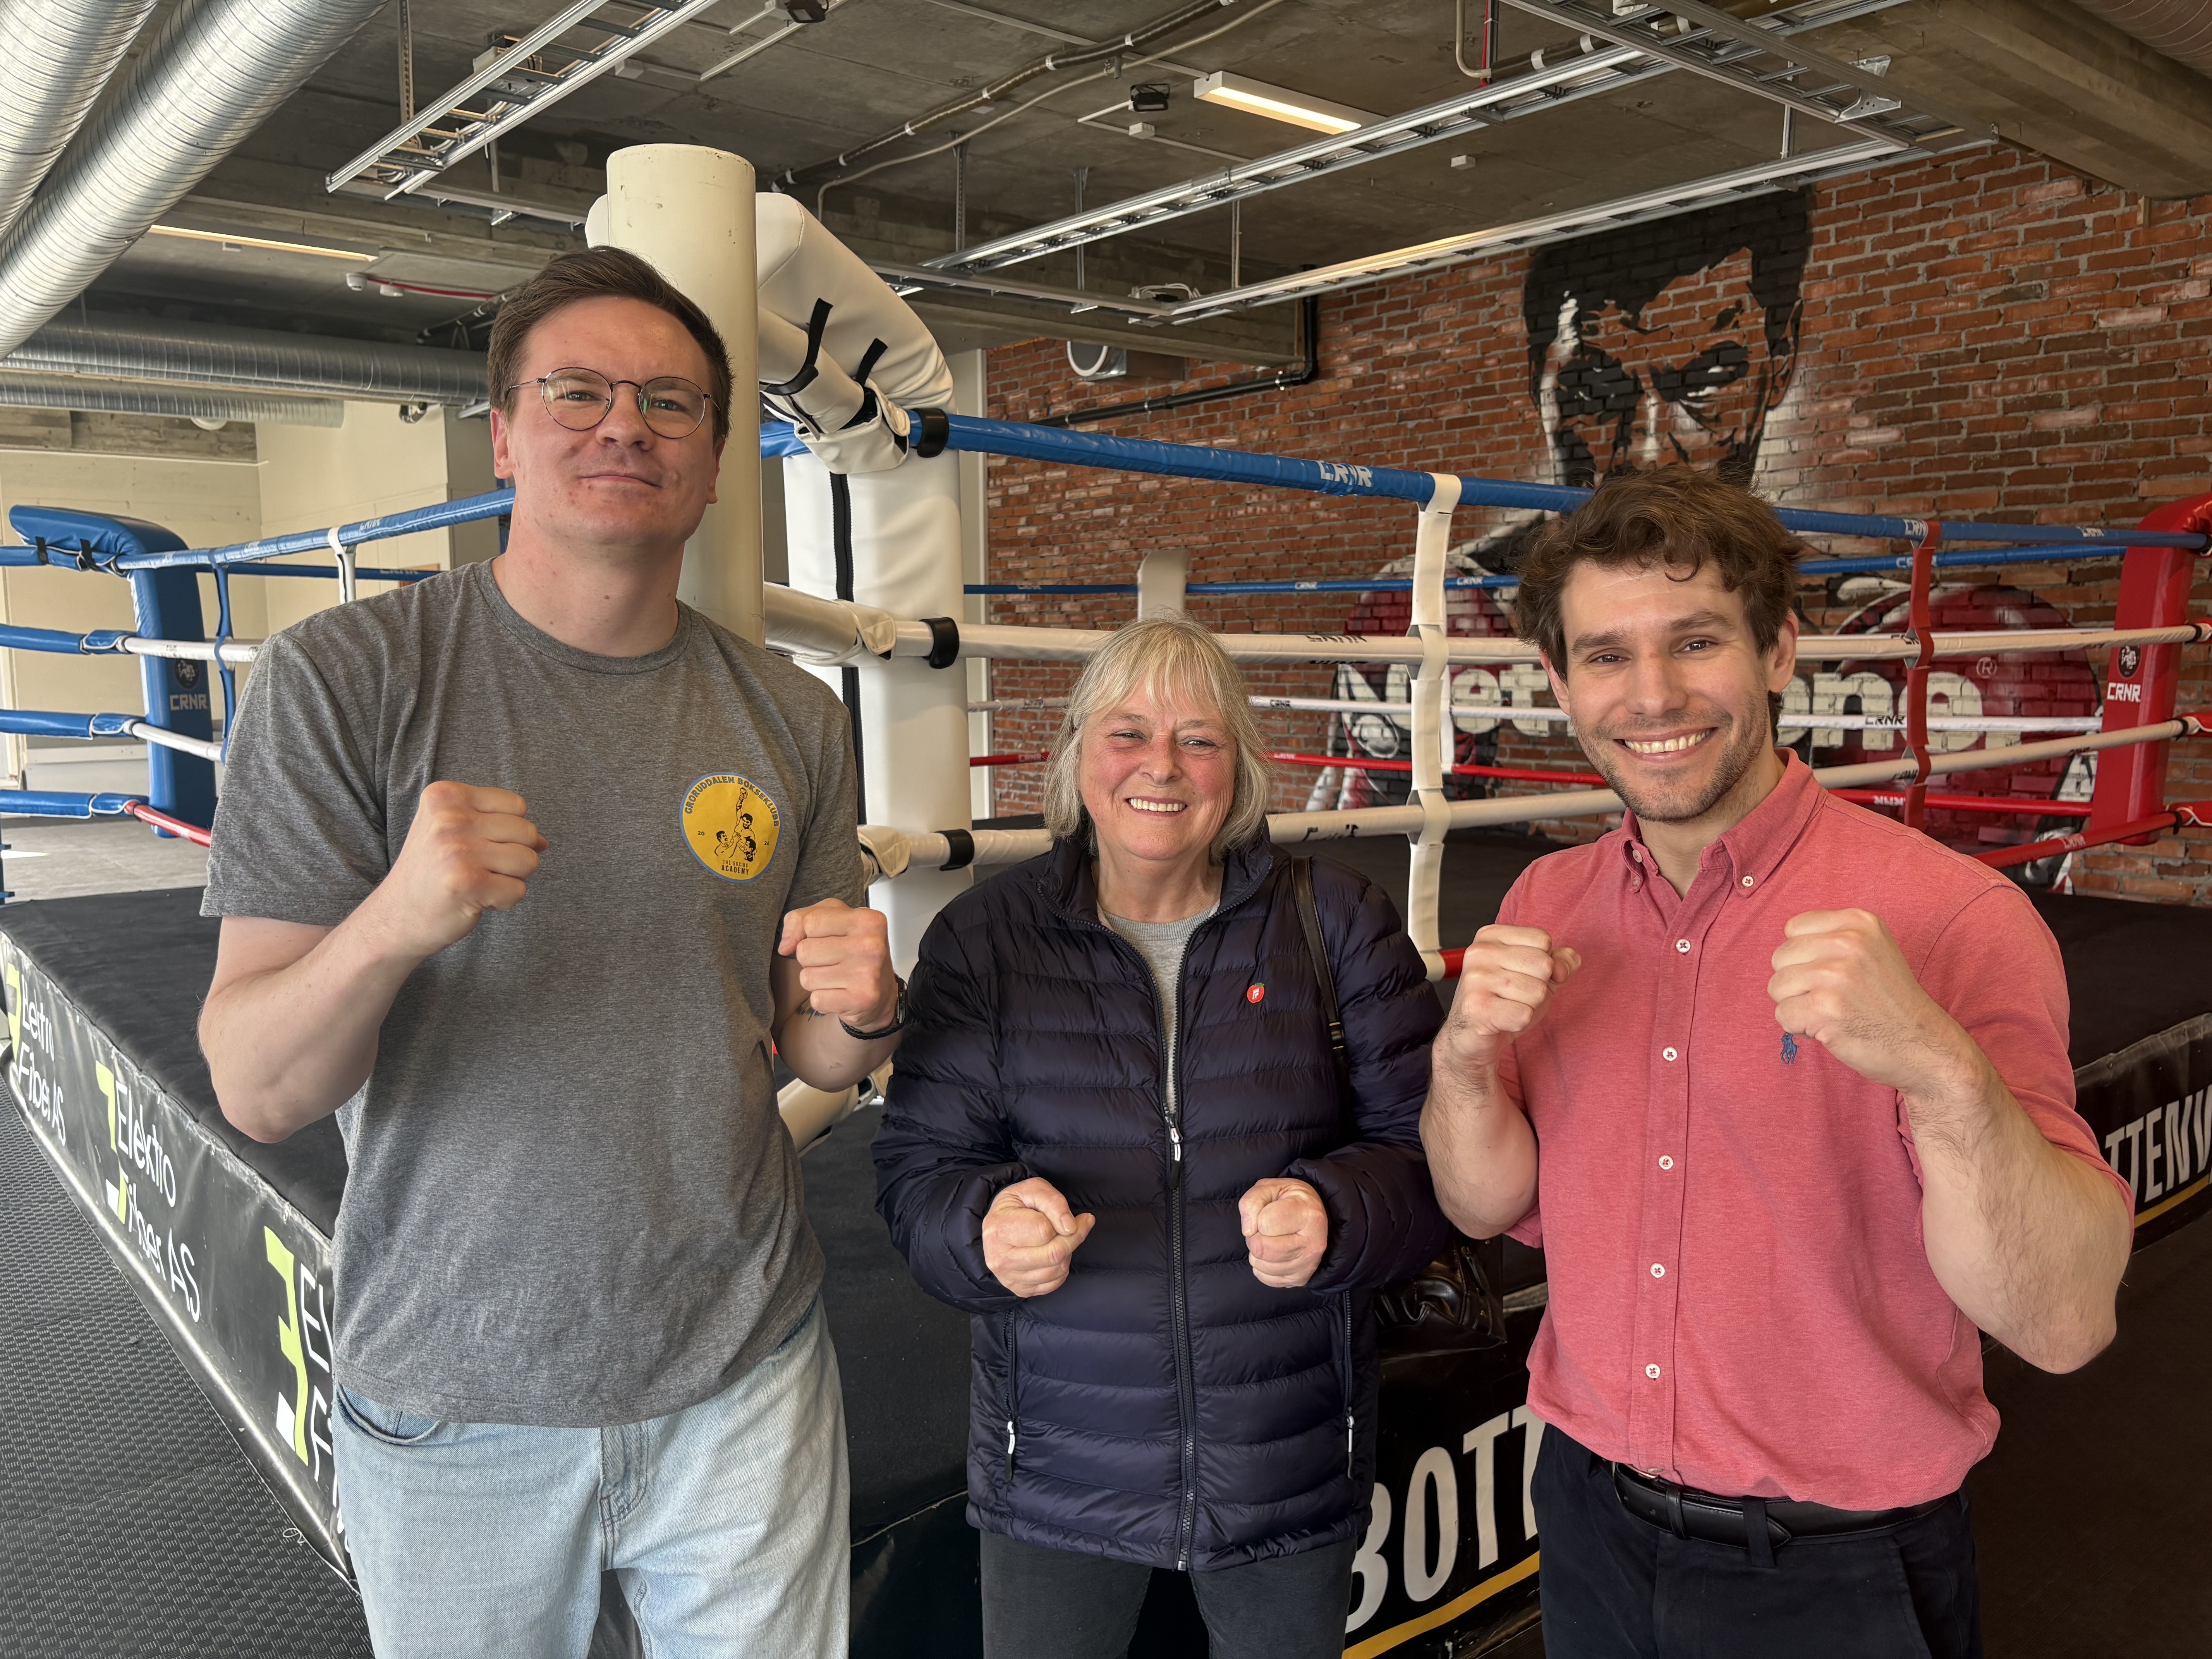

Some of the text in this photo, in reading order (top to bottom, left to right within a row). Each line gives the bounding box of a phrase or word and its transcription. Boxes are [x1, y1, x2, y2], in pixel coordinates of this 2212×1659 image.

[1903, 519, 1928, 536] CRN
[169, 693, 208, 711] CRNR
[2107, 682, 2141, 702] CRNR
[1865, 714, 1905, 725] CRNR
[685, 776, 780, 827] GRORUDDALEN BOKSEKLUBB
[721, 865, 749, 875] ACADEMY
[52, 1077, 66, 1146] AS
[116, 1079, 176, 1208] Elektro
[168, 1227, 200, 1322] AS
[1345, 1403, 1546, 1634] BOTT
